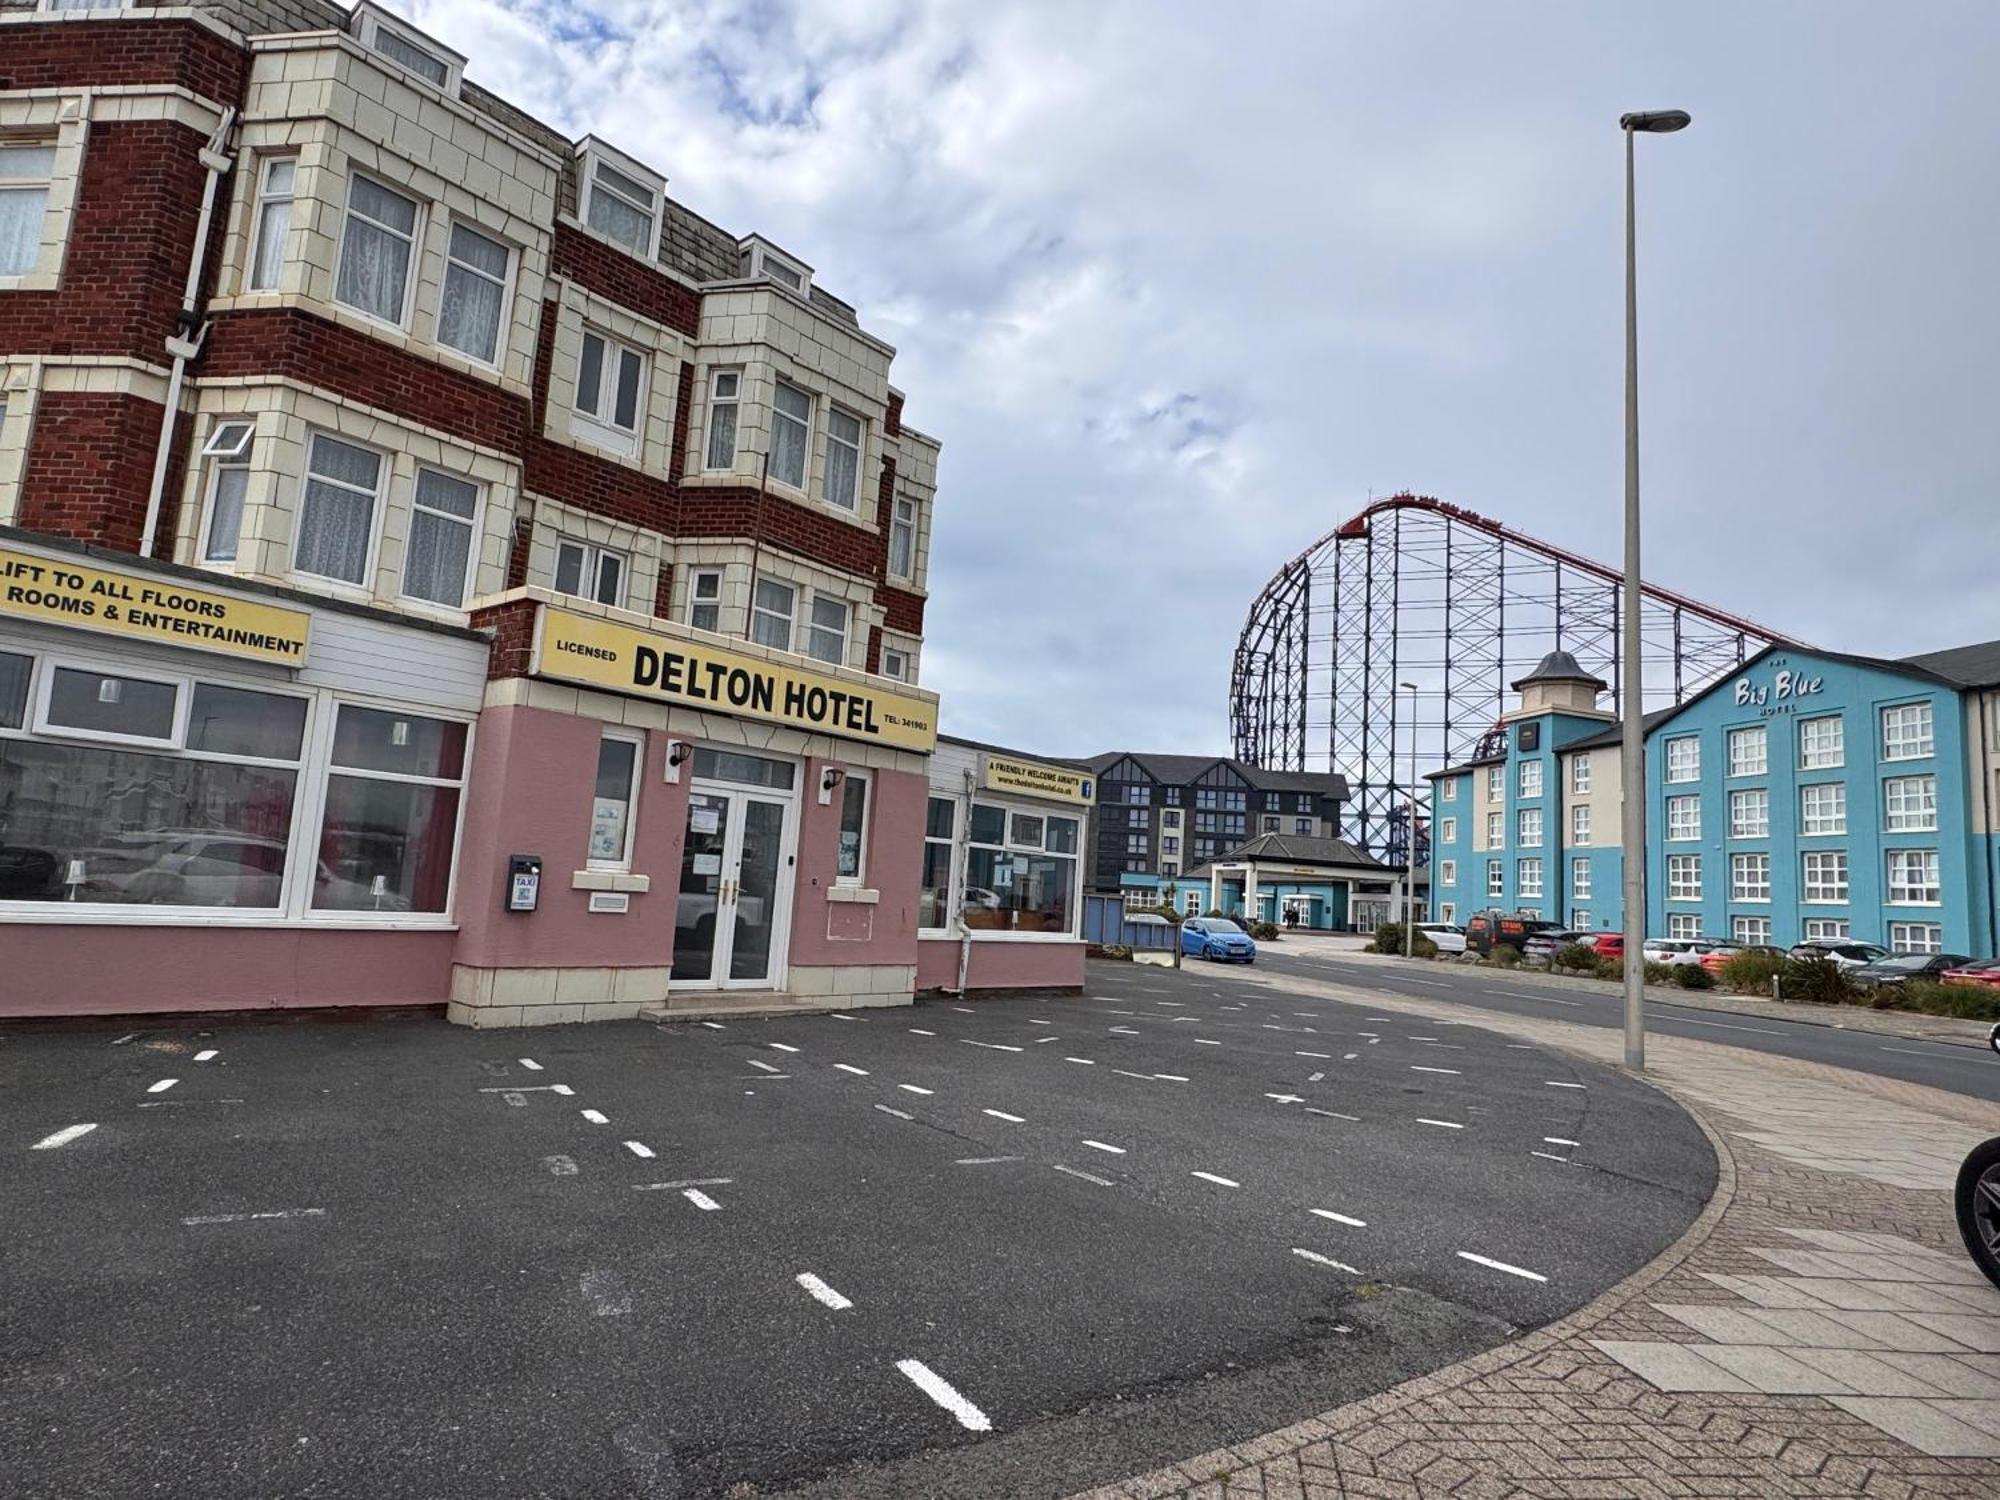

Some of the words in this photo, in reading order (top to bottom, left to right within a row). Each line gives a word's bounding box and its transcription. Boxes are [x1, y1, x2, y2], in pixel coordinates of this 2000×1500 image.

[53, 570, 84, 591] TO
[90, 580, 134, 601] ALL
[141, 590, 227, 618] FLOORS
[7, 586, 96, 616] ROOMS
[103, 604, 119, 621] &
[127, 608, 304, 655] ENTERTAINMENT
[556, 639, 617, 663] LICENSED
[633, 645, 776, 713] DELTON
[783, 679, 880, 735] HOTEL
[1735, 678, 1769, 705] Big
[1775, 670, 1824, 700] Blue
[989, 762, 994, 770] A
[995, 763, 1026, 777] FRIENDLY
[1027, 770, 1057, 782] WELCOME
[1057, 776, 1080, 786] AWAITS
[516, 878, 535, 886] TAXI
